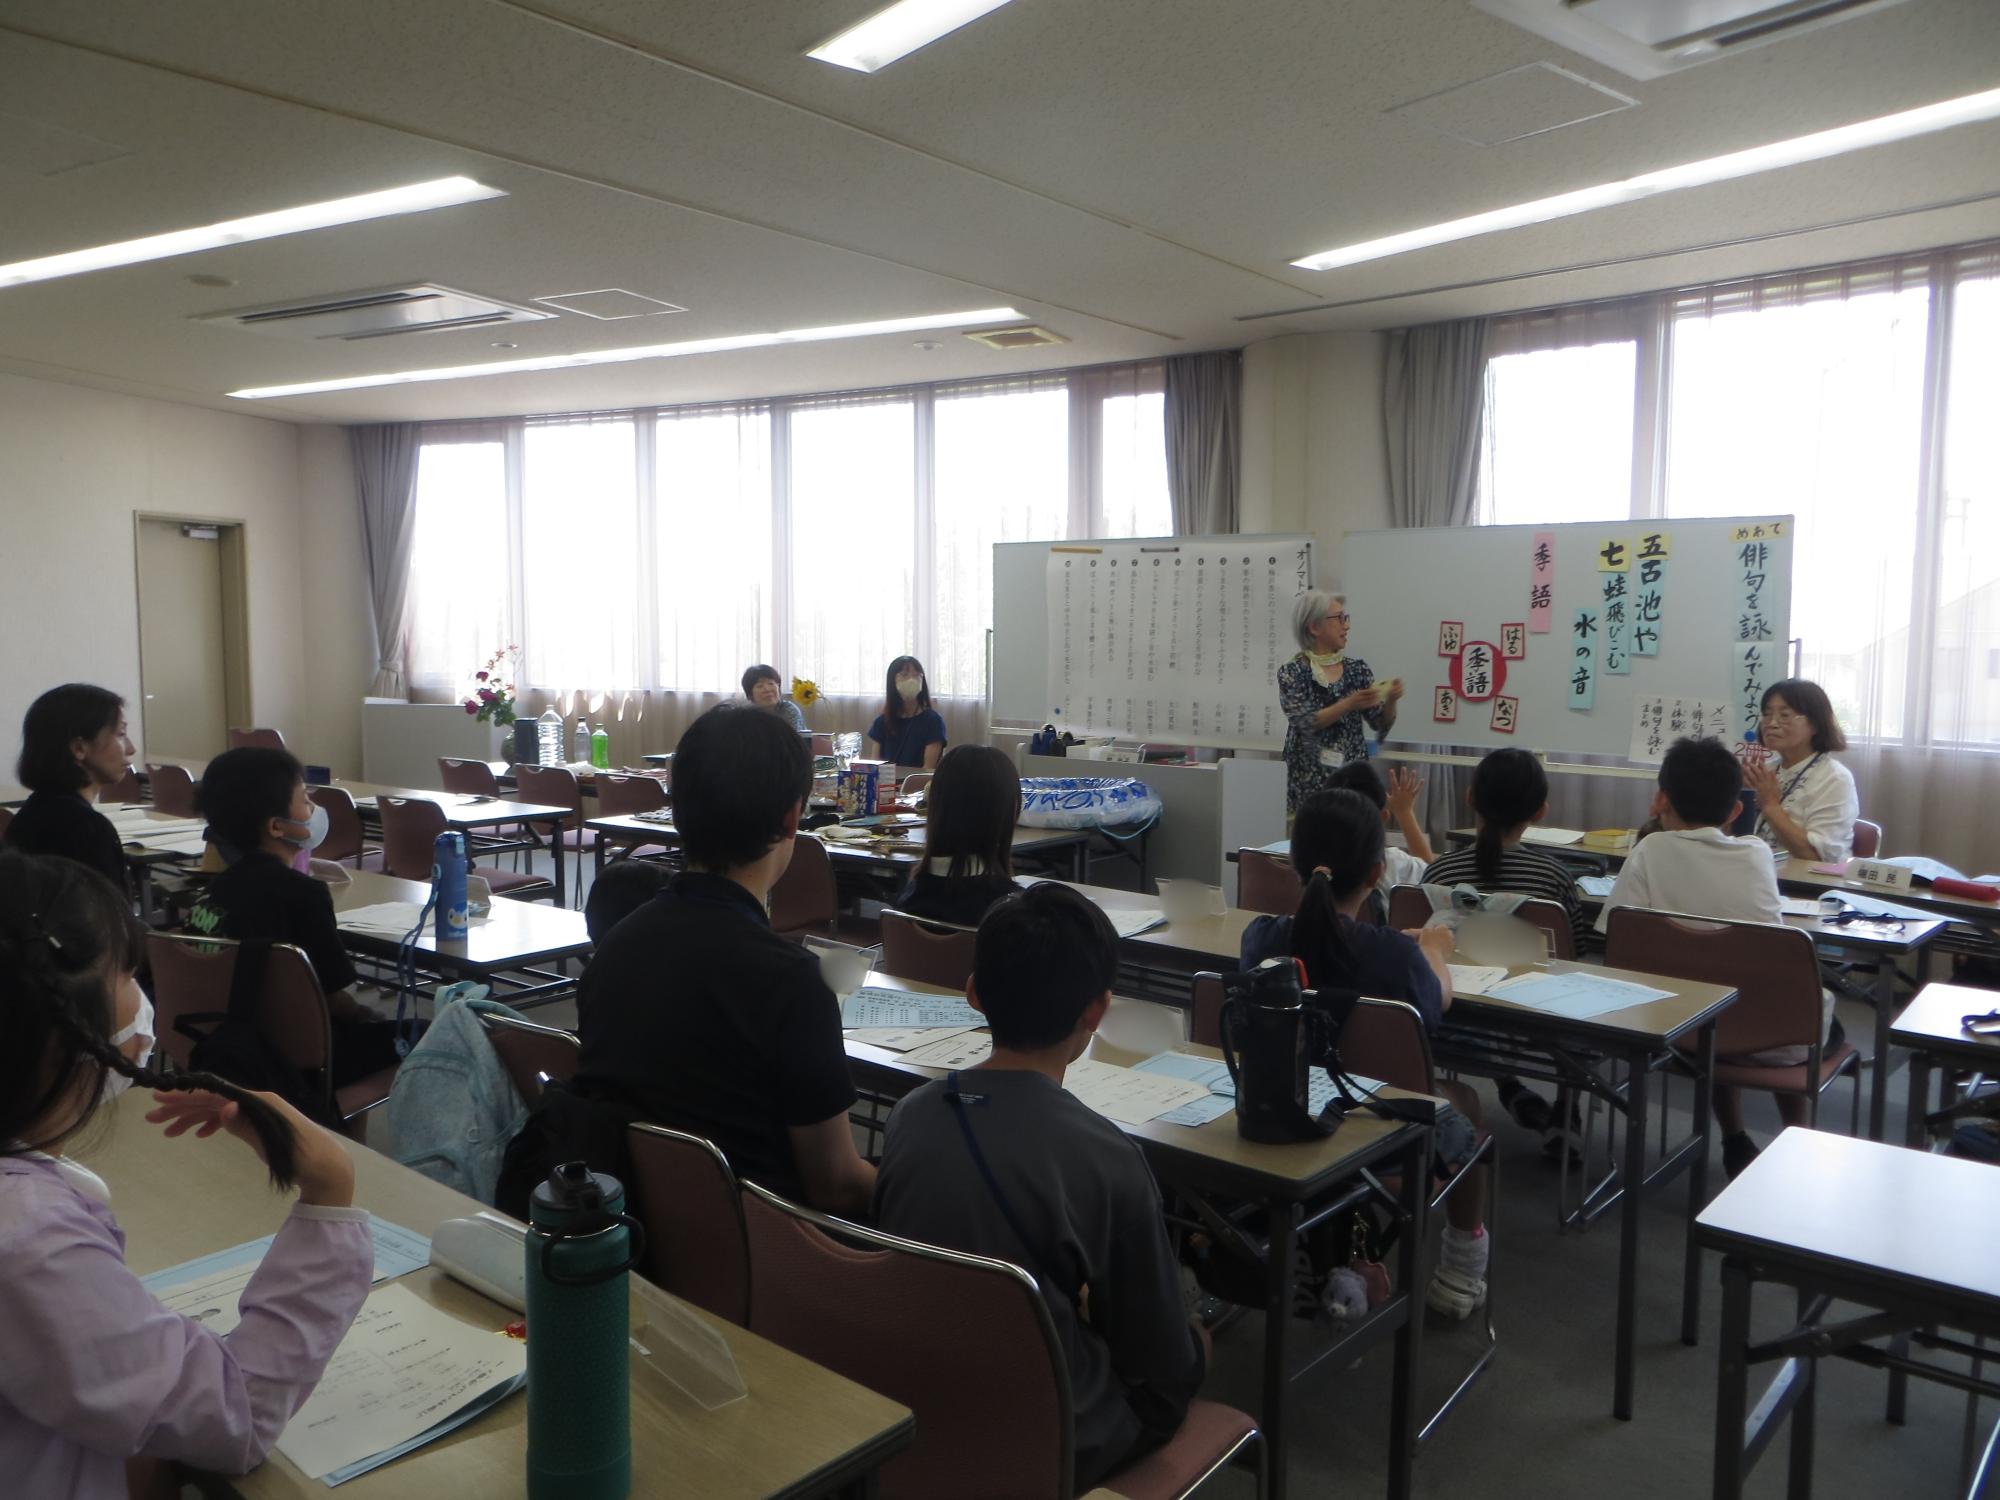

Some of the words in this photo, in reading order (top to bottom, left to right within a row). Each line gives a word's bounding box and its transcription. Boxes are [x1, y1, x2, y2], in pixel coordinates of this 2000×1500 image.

[1736, 523, 1780, 539] めあて
[1600, 541, 1624, 566] 七
[1637, 534, 1667, 559] 五
[1530, 544, 1551, 609] 季語
[1634, 560, 1661, 652] 古池や
[1603, 574, 1628, 669] 蛙飛びこむ
[1443, 626, 1458, 650] ふゆ
[1506, 628, 1520, 655] はる
[1738, 543, 1772, 730] 俳句を詠んでみよう
[1572, 613, 1597, 695] 水の音
[1465, 647, 1490, 694] 季語
[1440, 690, 1453, 717] あき
[1496, 700, 1512, 726] なつ
[1709, 705, 1728, 734] メニュ
